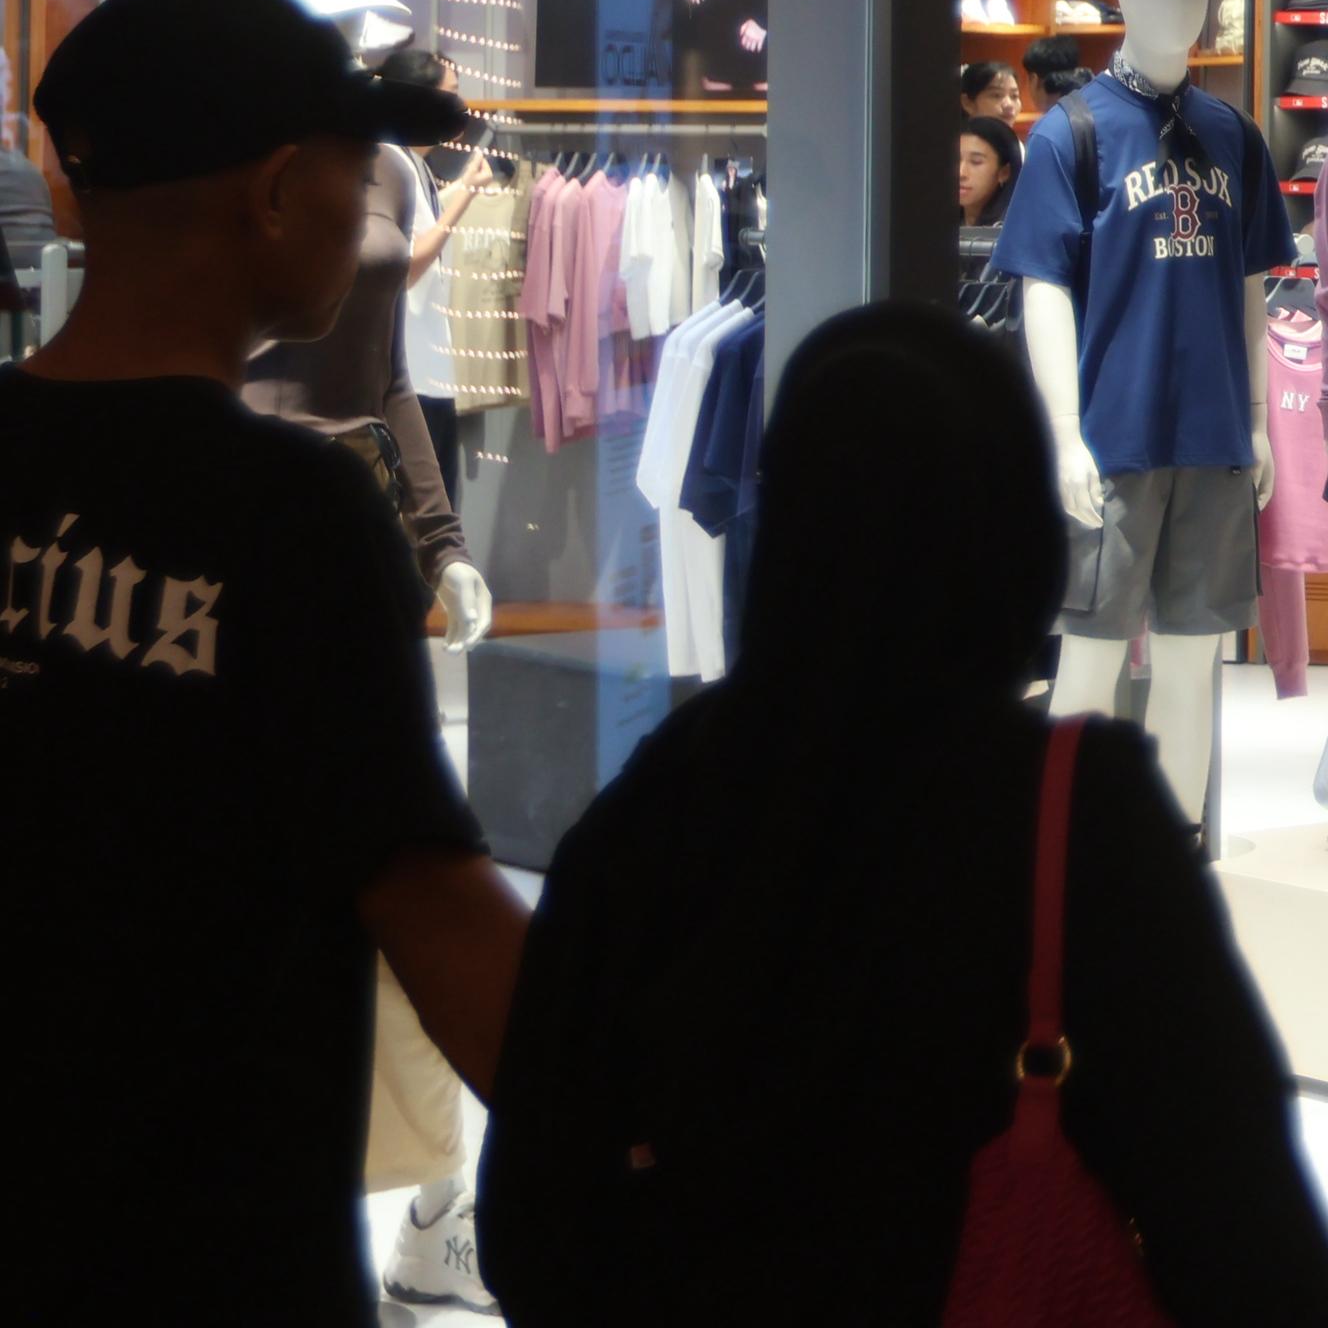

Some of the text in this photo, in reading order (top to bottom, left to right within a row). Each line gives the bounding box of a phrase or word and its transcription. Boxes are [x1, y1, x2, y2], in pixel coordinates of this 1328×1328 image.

[1171, 183, 1201, 241] B
[1154, 235, 1215, 260] BOSTON
[1280, 391, 1311, 412] NY
[443, 1235, 475, 1275] NY
